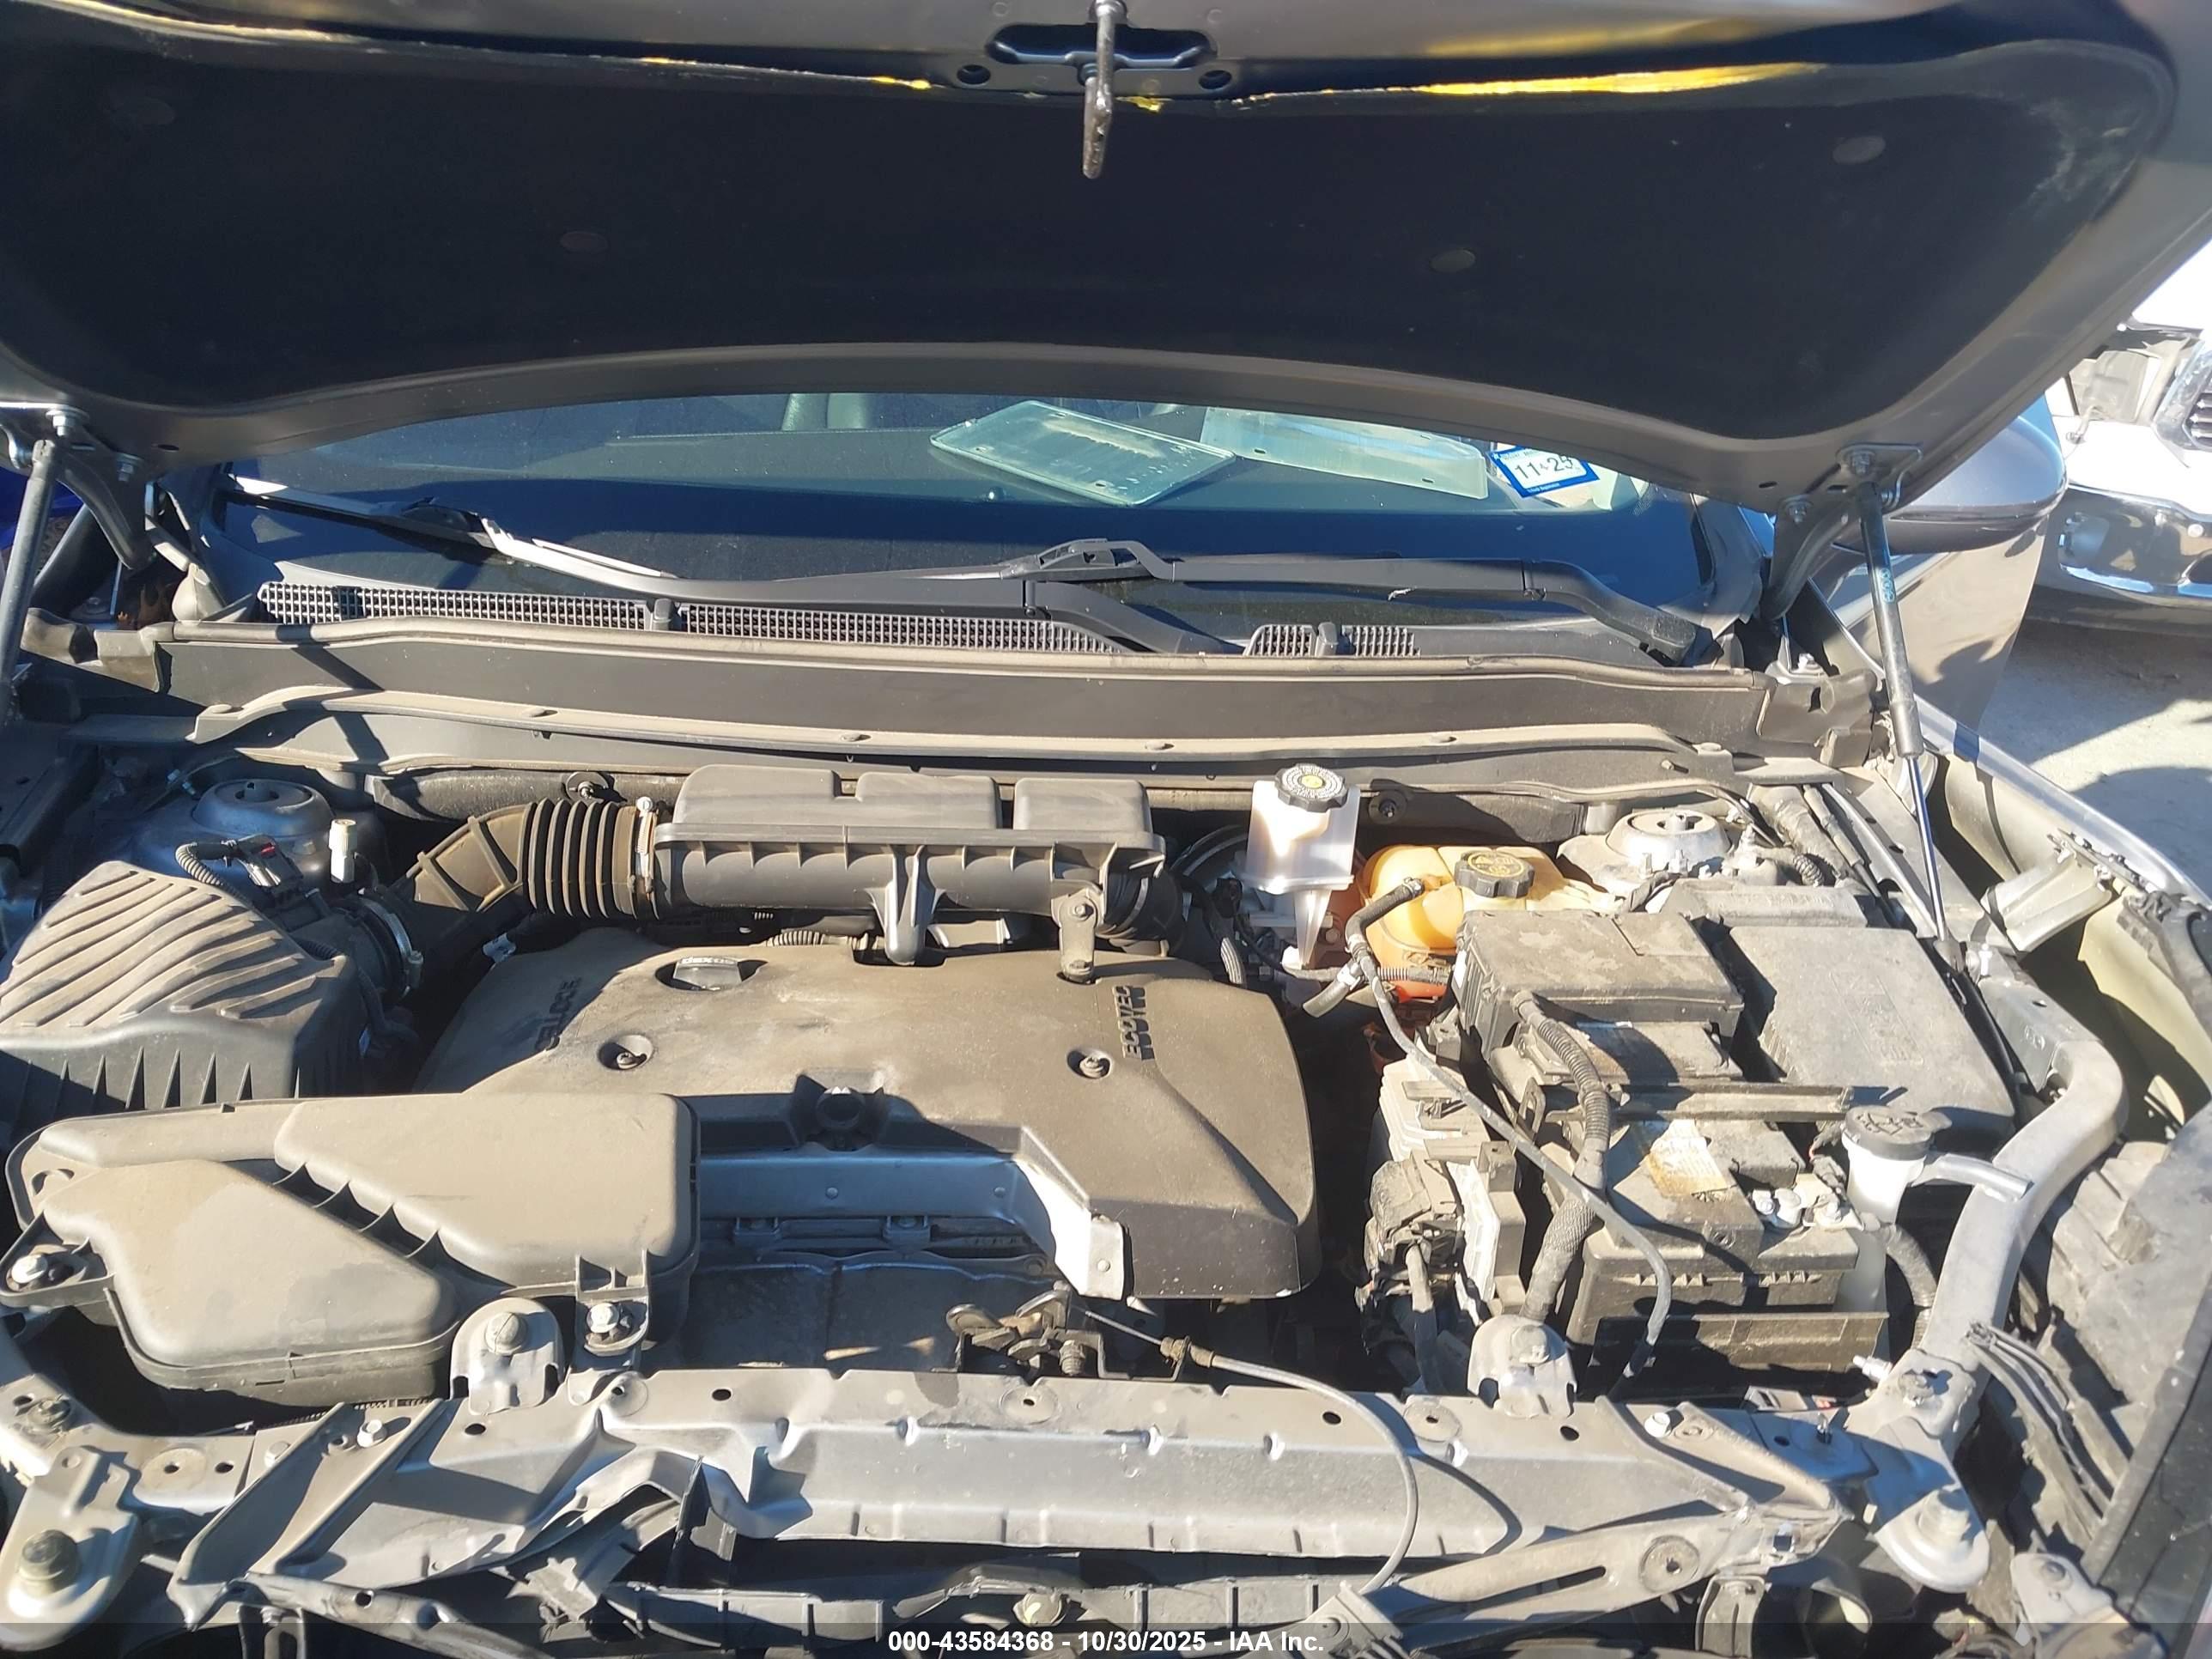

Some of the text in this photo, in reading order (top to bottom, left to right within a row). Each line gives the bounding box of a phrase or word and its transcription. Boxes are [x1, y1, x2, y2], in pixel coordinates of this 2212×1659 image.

[1515, 462, 1540, 479] 11
[682, 956, 735, 964] dexos
[1113, 985, 1146, 1060] ECOTEC
